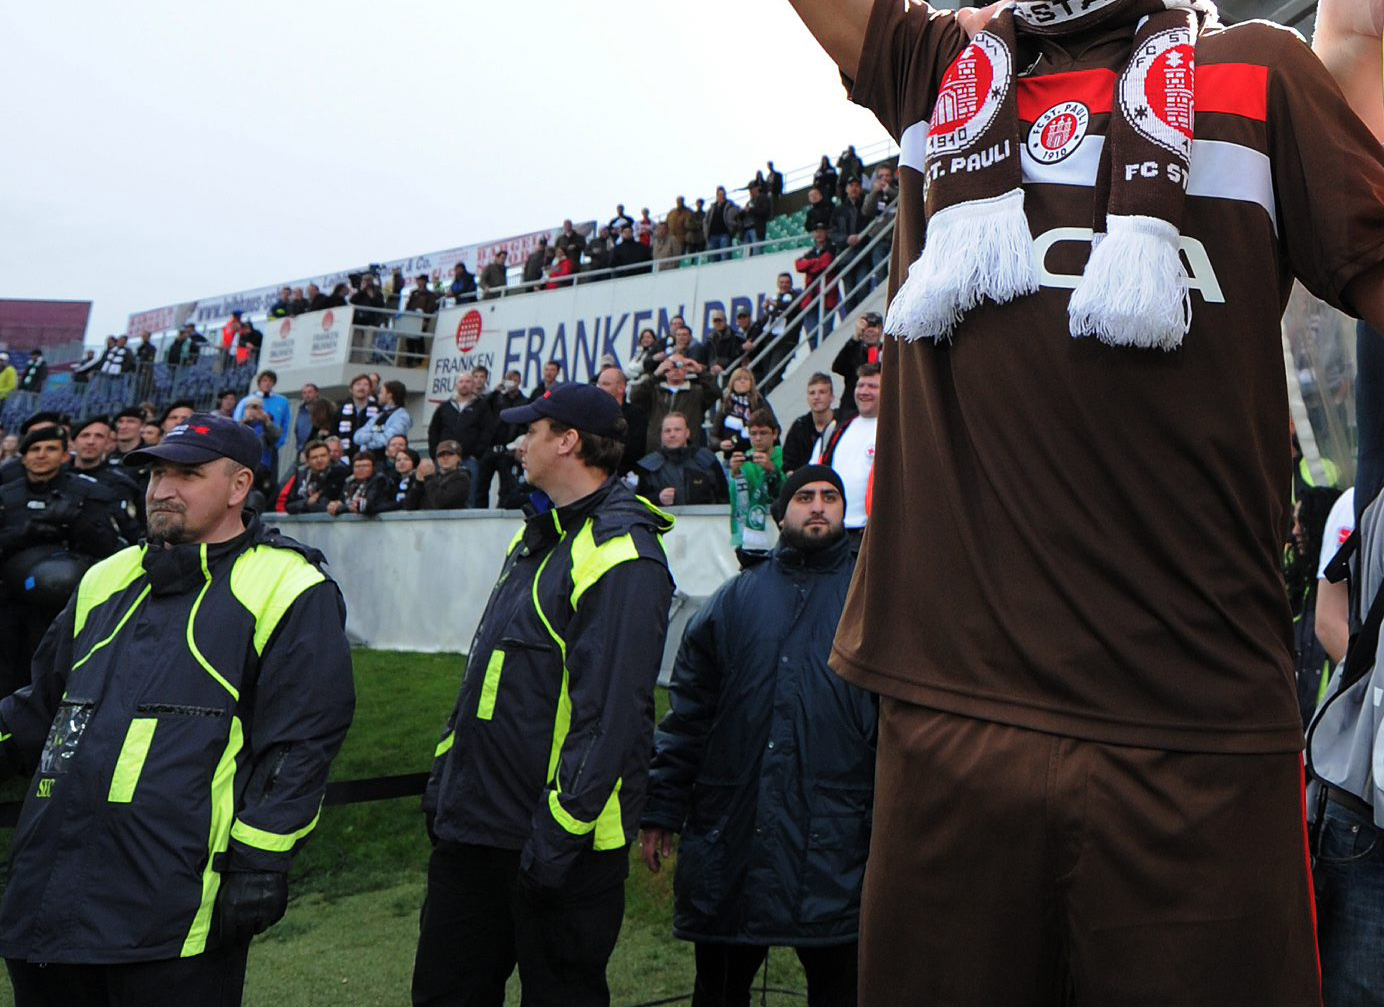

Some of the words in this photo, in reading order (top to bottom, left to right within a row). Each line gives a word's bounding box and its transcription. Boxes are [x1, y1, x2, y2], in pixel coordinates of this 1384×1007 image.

[1033, 122, 1045, 135] FC
[1044, 108, 1061, 121] ST.
[1064, 103, 1087, 126] PAULI
[950, 139, 1011, 174] PAULI
[1042, 147, 1067, 160] 1910
[1125, 161, 1159, 182] FC
[434, 351, 495, 375] FRANKEN
